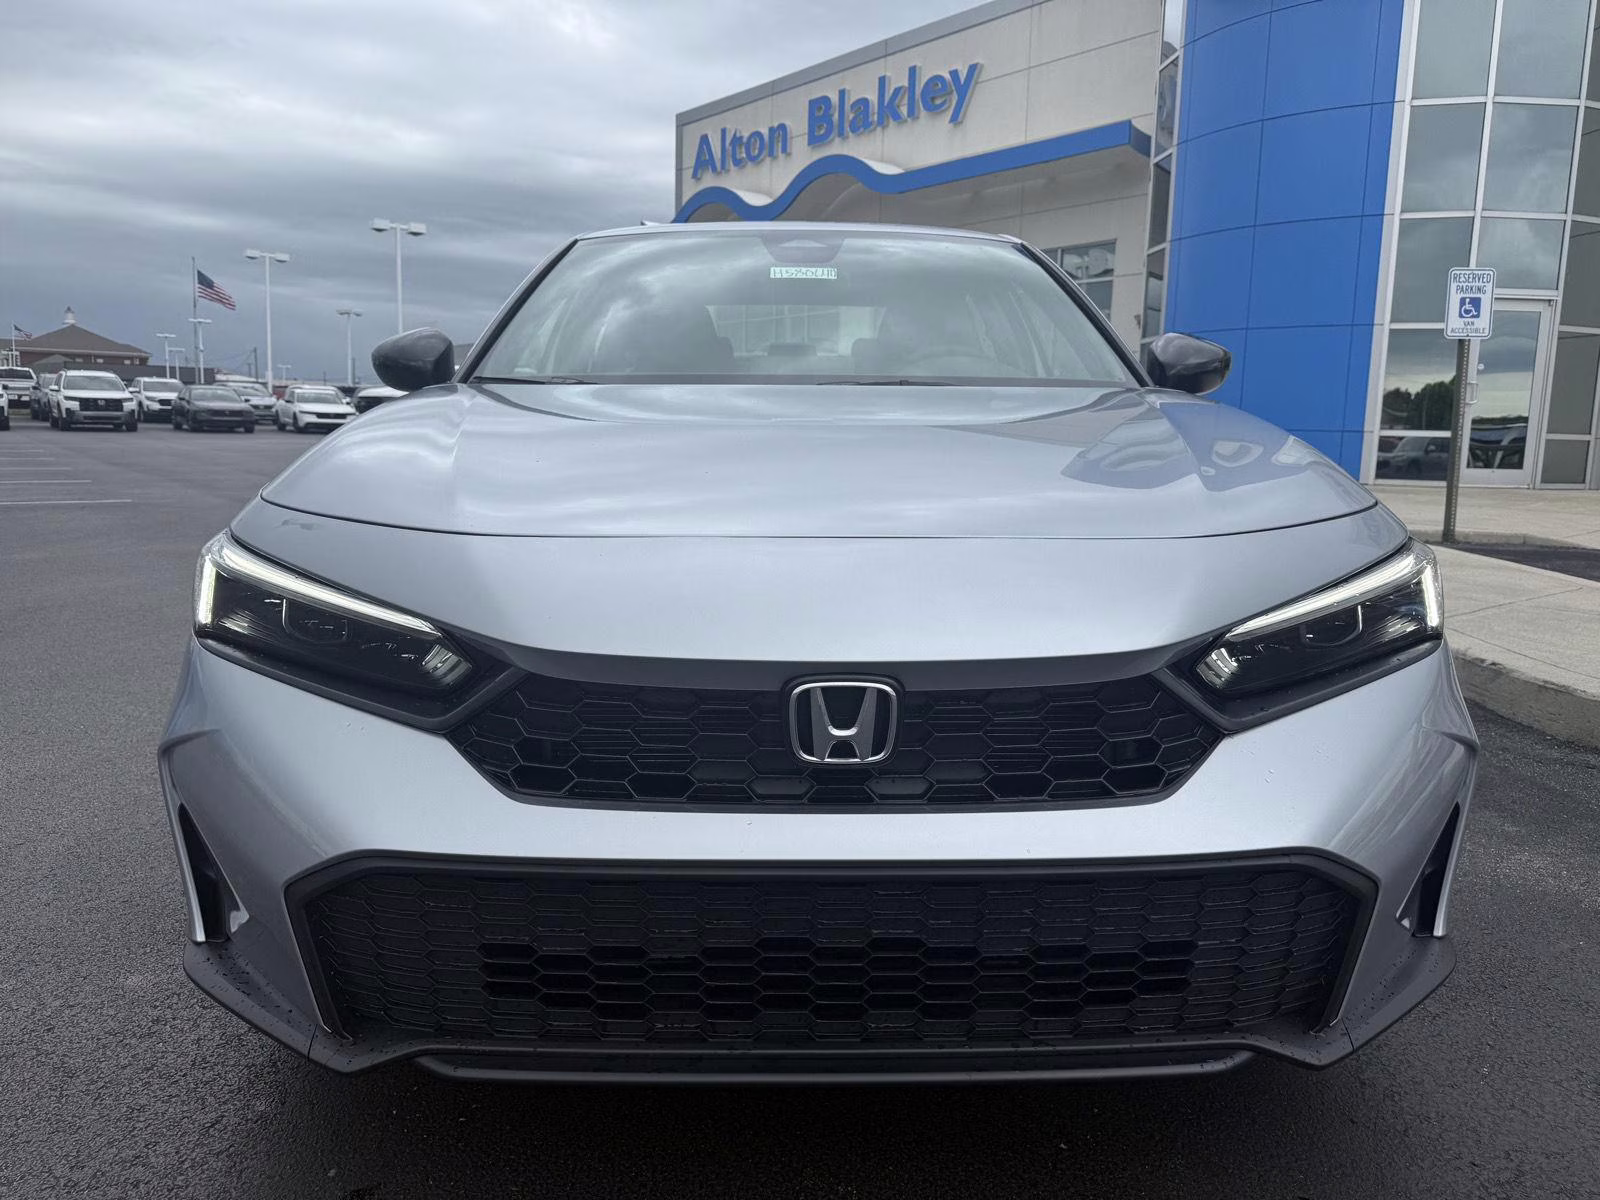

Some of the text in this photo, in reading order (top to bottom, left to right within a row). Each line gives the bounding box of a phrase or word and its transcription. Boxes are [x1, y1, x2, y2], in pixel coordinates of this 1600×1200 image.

[692, 62, 982, 180] Alton Blakley
[1453, 272, 1492, 284] RESERVED
[1456, 284, 1487, 295] PARKING
